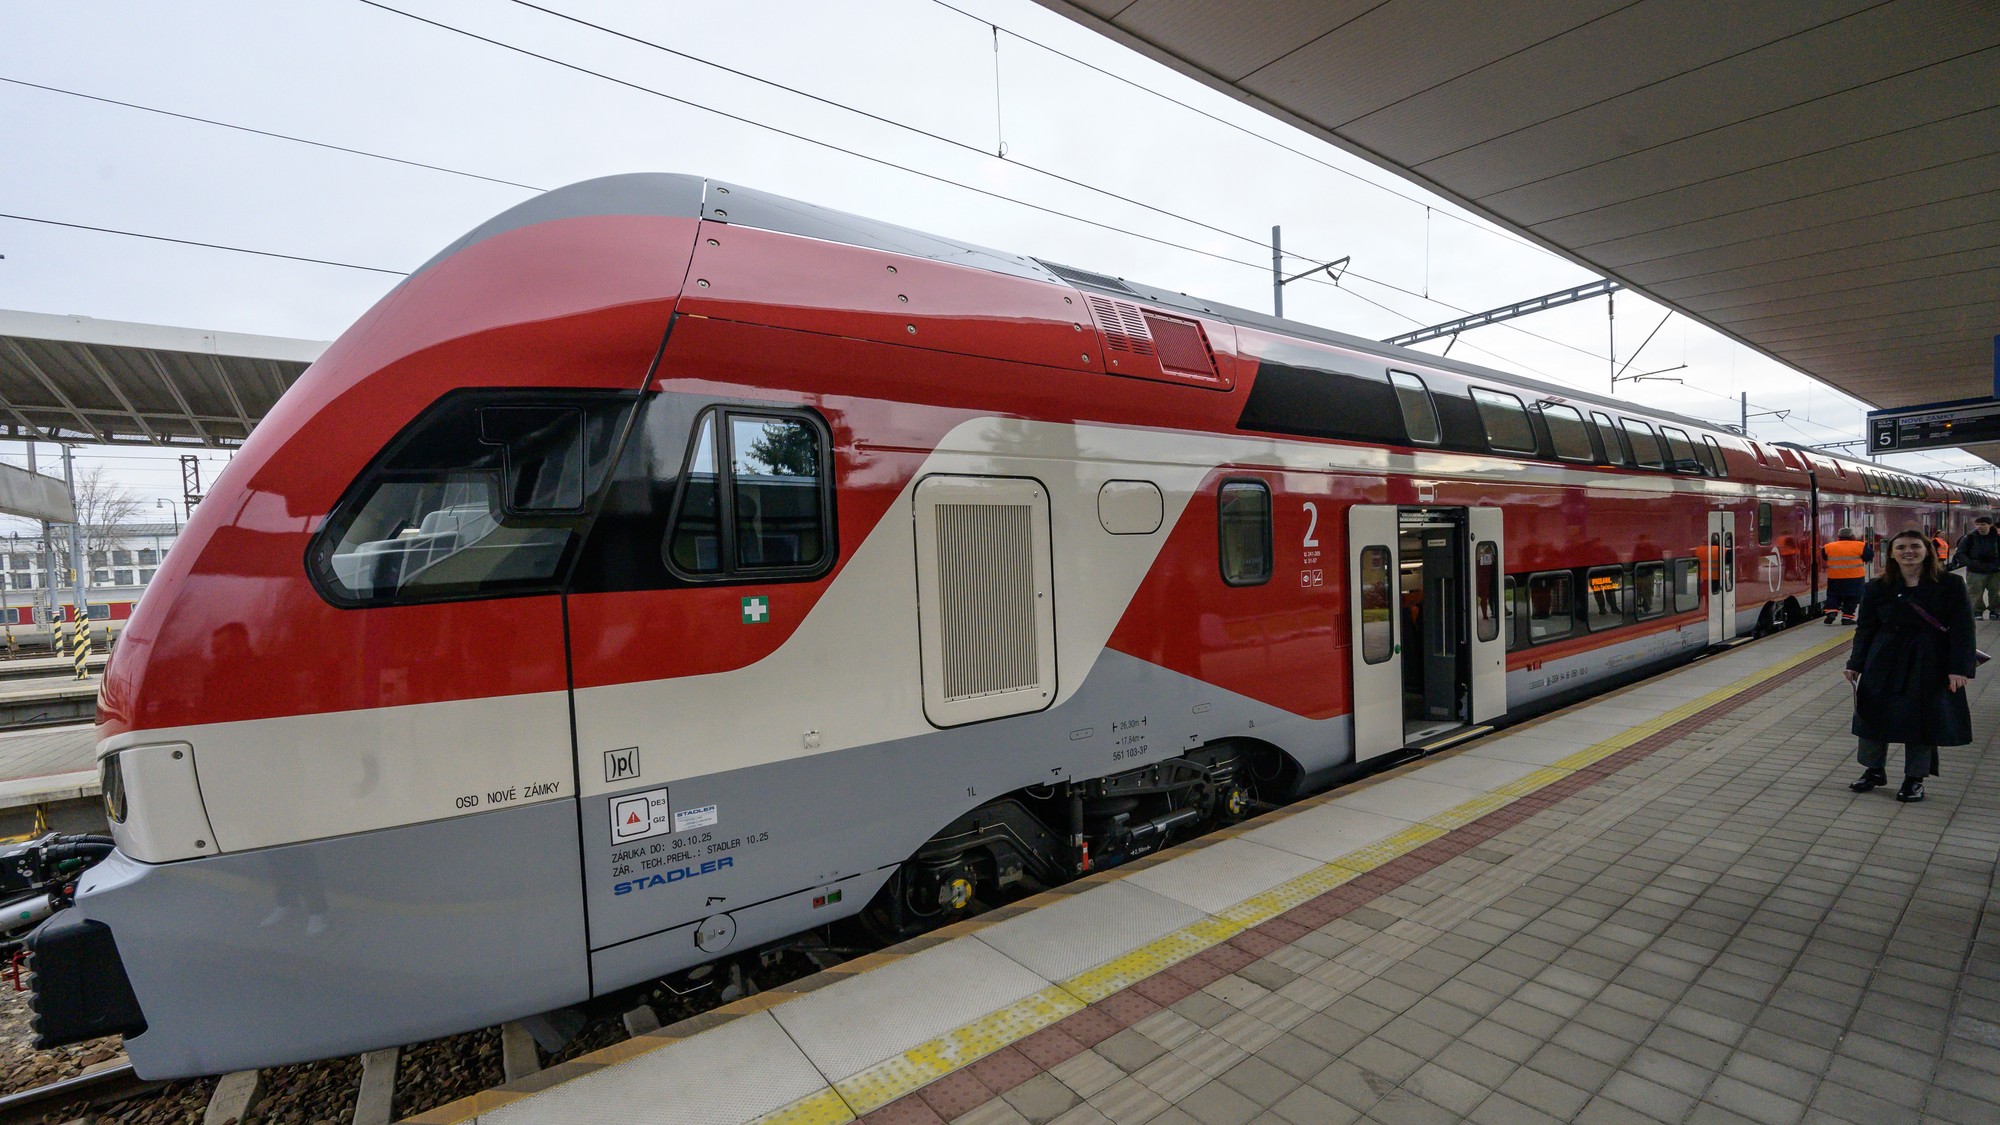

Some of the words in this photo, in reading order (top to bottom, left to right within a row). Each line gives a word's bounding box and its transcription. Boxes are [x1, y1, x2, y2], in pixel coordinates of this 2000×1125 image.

[1880, 432, 1891, 446] 5
[1302, 501, 1319, 548] 2
[1112, 751, 1124, 761] 561
[1126, 745, 1148, 758] 103-3P
[455, 795, 479, 809] OSD
[487, 786, 516, 804] NOVÉ
[524, 781, 560, 798] ZÁMKY
[650, 798, 666, 807] DE3
[967, 786, 977, 798] 1L
[676, 806, 715, 817] STADLER
[611, 847, 646, 863] ZÁRUKA
[650, 843, 665, 854] DO:
[672, 832, 712, 849] 30.10.25
[612, 863, 634, 878] ZÁR.
[707, 838, 741, 855] STADLER
[746, 832, 769, 845] 10.25
[613, 856, 734, 896] STADLER
